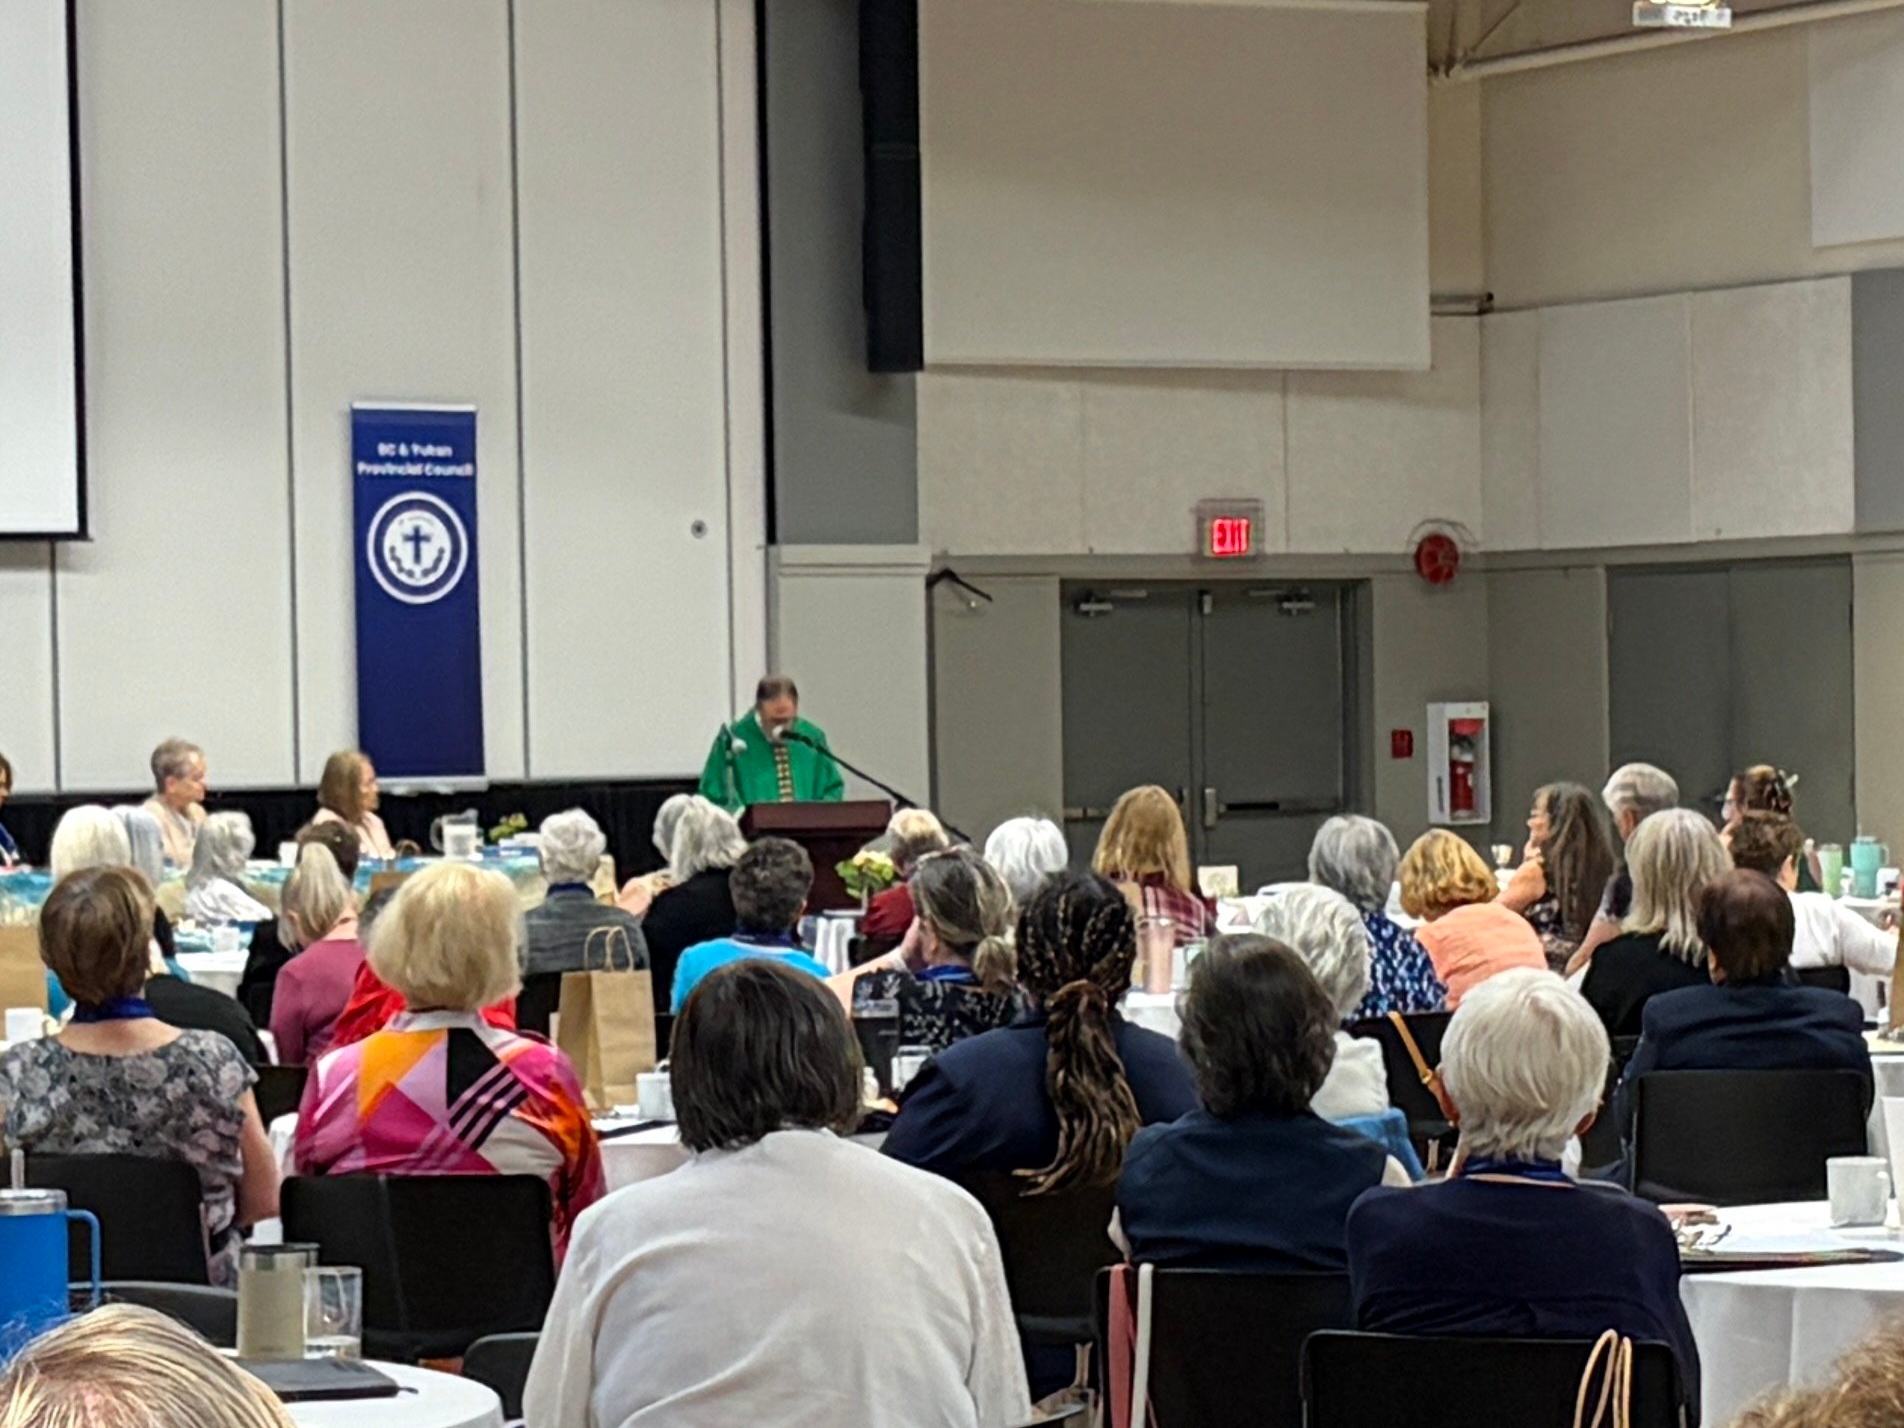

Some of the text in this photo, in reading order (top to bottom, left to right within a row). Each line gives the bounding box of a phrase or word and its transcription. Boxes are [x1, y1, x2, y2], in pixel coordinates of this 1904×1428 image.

[357, 461, 474, 477] Provincial Council
[1213, 518, 1248, 553] EXIT
